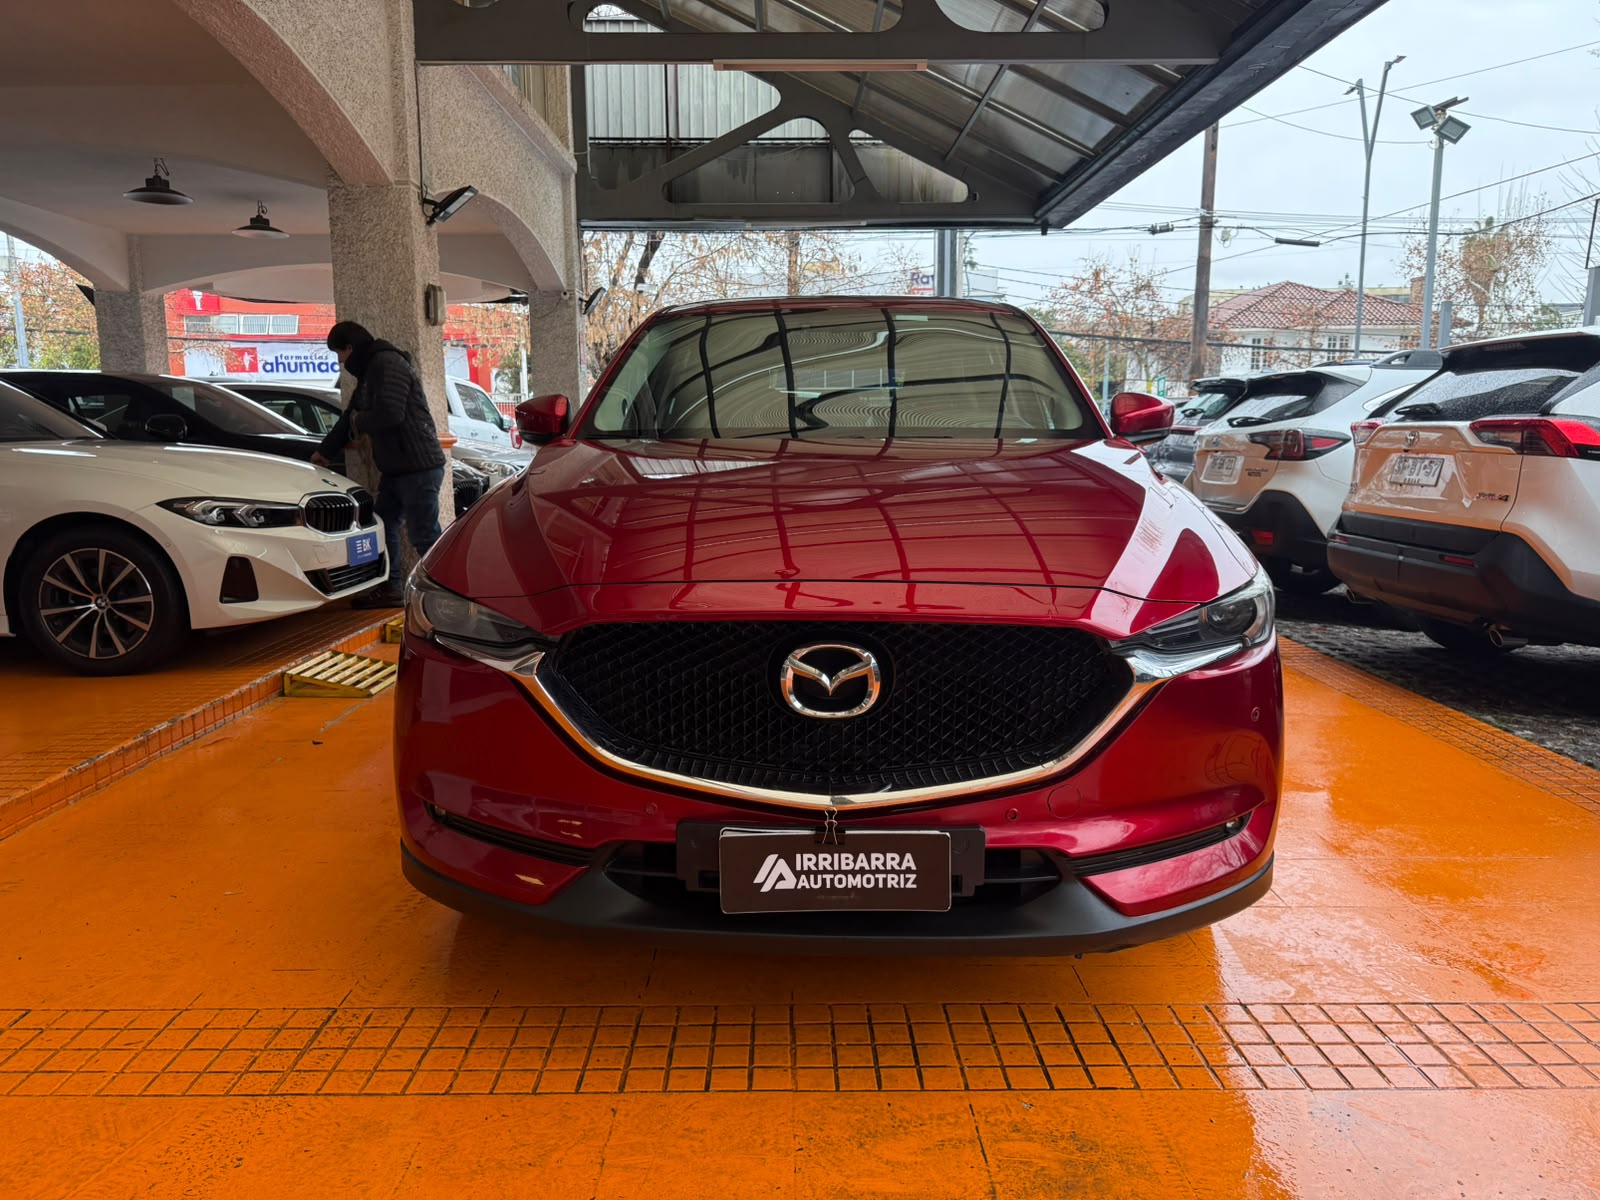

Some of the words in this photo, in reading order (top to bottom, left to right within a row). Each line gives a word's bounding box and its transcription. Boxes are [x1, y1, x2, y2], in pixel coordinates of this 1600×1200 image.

[279, 353, 329, 361] farmacias
[795, 852, 917, 871] IRRIBARRA
[796, 873, 917, 889] AUTOMOTRIZ
